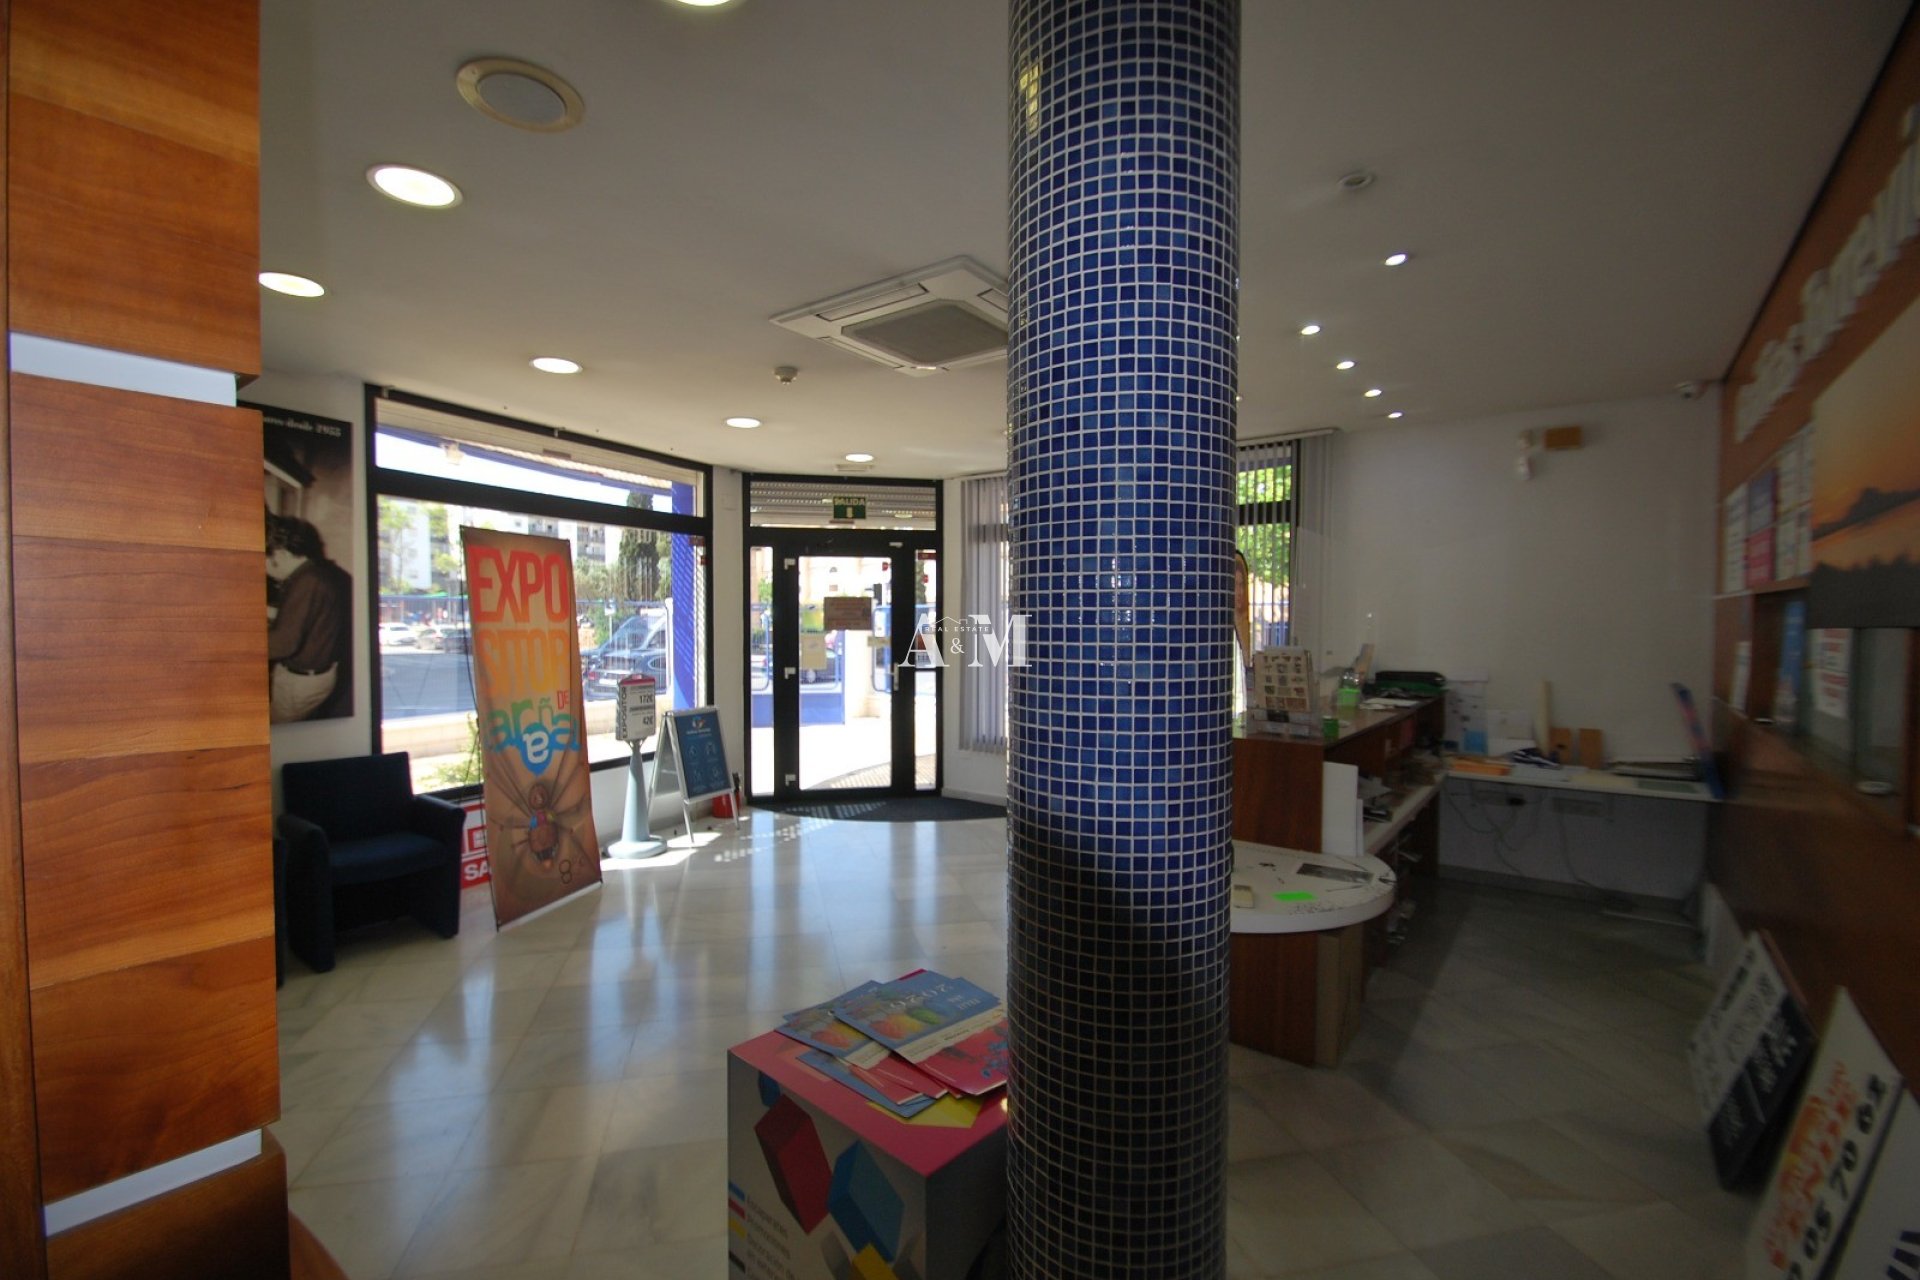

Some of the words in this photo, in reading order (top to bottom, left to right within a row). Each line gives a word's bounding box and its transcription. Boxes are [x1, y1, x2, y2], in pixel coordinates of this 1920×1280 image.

[467, 544, 569, 624] EXPO
[475, 627, 570, 698] SITOR
[557, 690, 569, 710] DE
